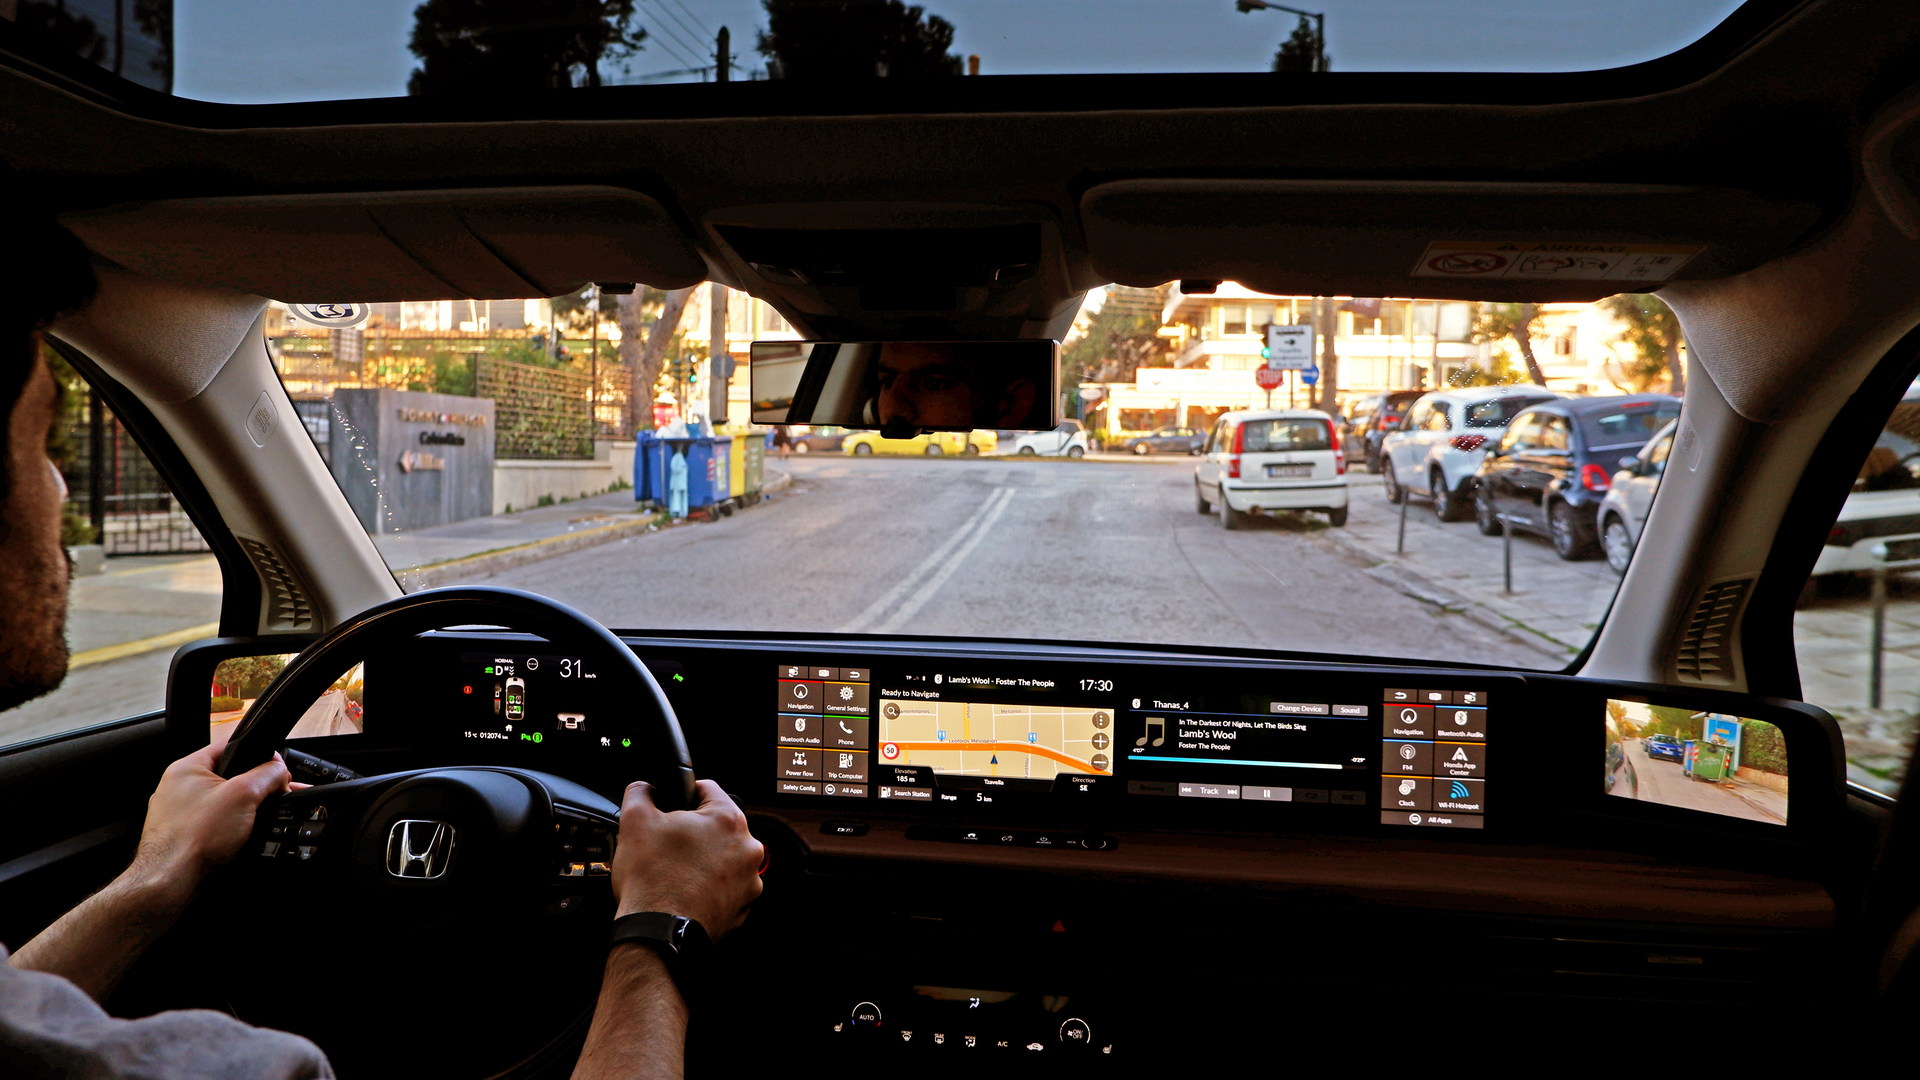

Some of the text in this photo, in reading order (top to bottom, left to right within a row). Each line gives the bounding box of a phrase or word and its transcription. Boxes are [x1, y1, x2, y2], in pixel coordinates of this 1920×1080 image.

[1533, 243, 1626, 253] AIRBAG
[495, 666, 503, 676] D
[559, 658, 582, 679] 31
[948, 676, 971, 684] Lamb's
[972, 676, 990, 685] Wool
[995, 678, 1017, 686] Foster
[1031, 679, 1055, 688] People
[1079, 679, 1114, 692] 17:30
[881, 689, 902, 698] Ready
[911, 690, 940, 699] Navigate
[787, 703, 815, 711] Navigation
[1152, 700, 1190, 710] Thanas_4
[1277, 704, 1323, 713] Change Device
[1198, 719, 1222, 727] Darkest
[1232, 720, 1253, 729] Nights,
[1253, 721, 1264, 729] Let
[1277, 722, 1293, 730] Birds
[1293, 723, 1307, 731] Sing
[479, 732, 502, 740] 012074
[1179, 728, 1237, 740] Lamb's Wool
[1393, 728, 1424, 736] Navigation
[1198, 742, 1210, 750] The
[1210, 743, 1231, 751] People
[838, 773, 864, 781] Computer
[896, 775, 908, 783] 185
[783, 784, 799, 792] Safety
[1199, 786, 1219, 795] Track
[976, 792, 983, 802] 5
[1455, 803, 1480, 811] Hotspot
[859, 1013, 875, 1021] AUTO
